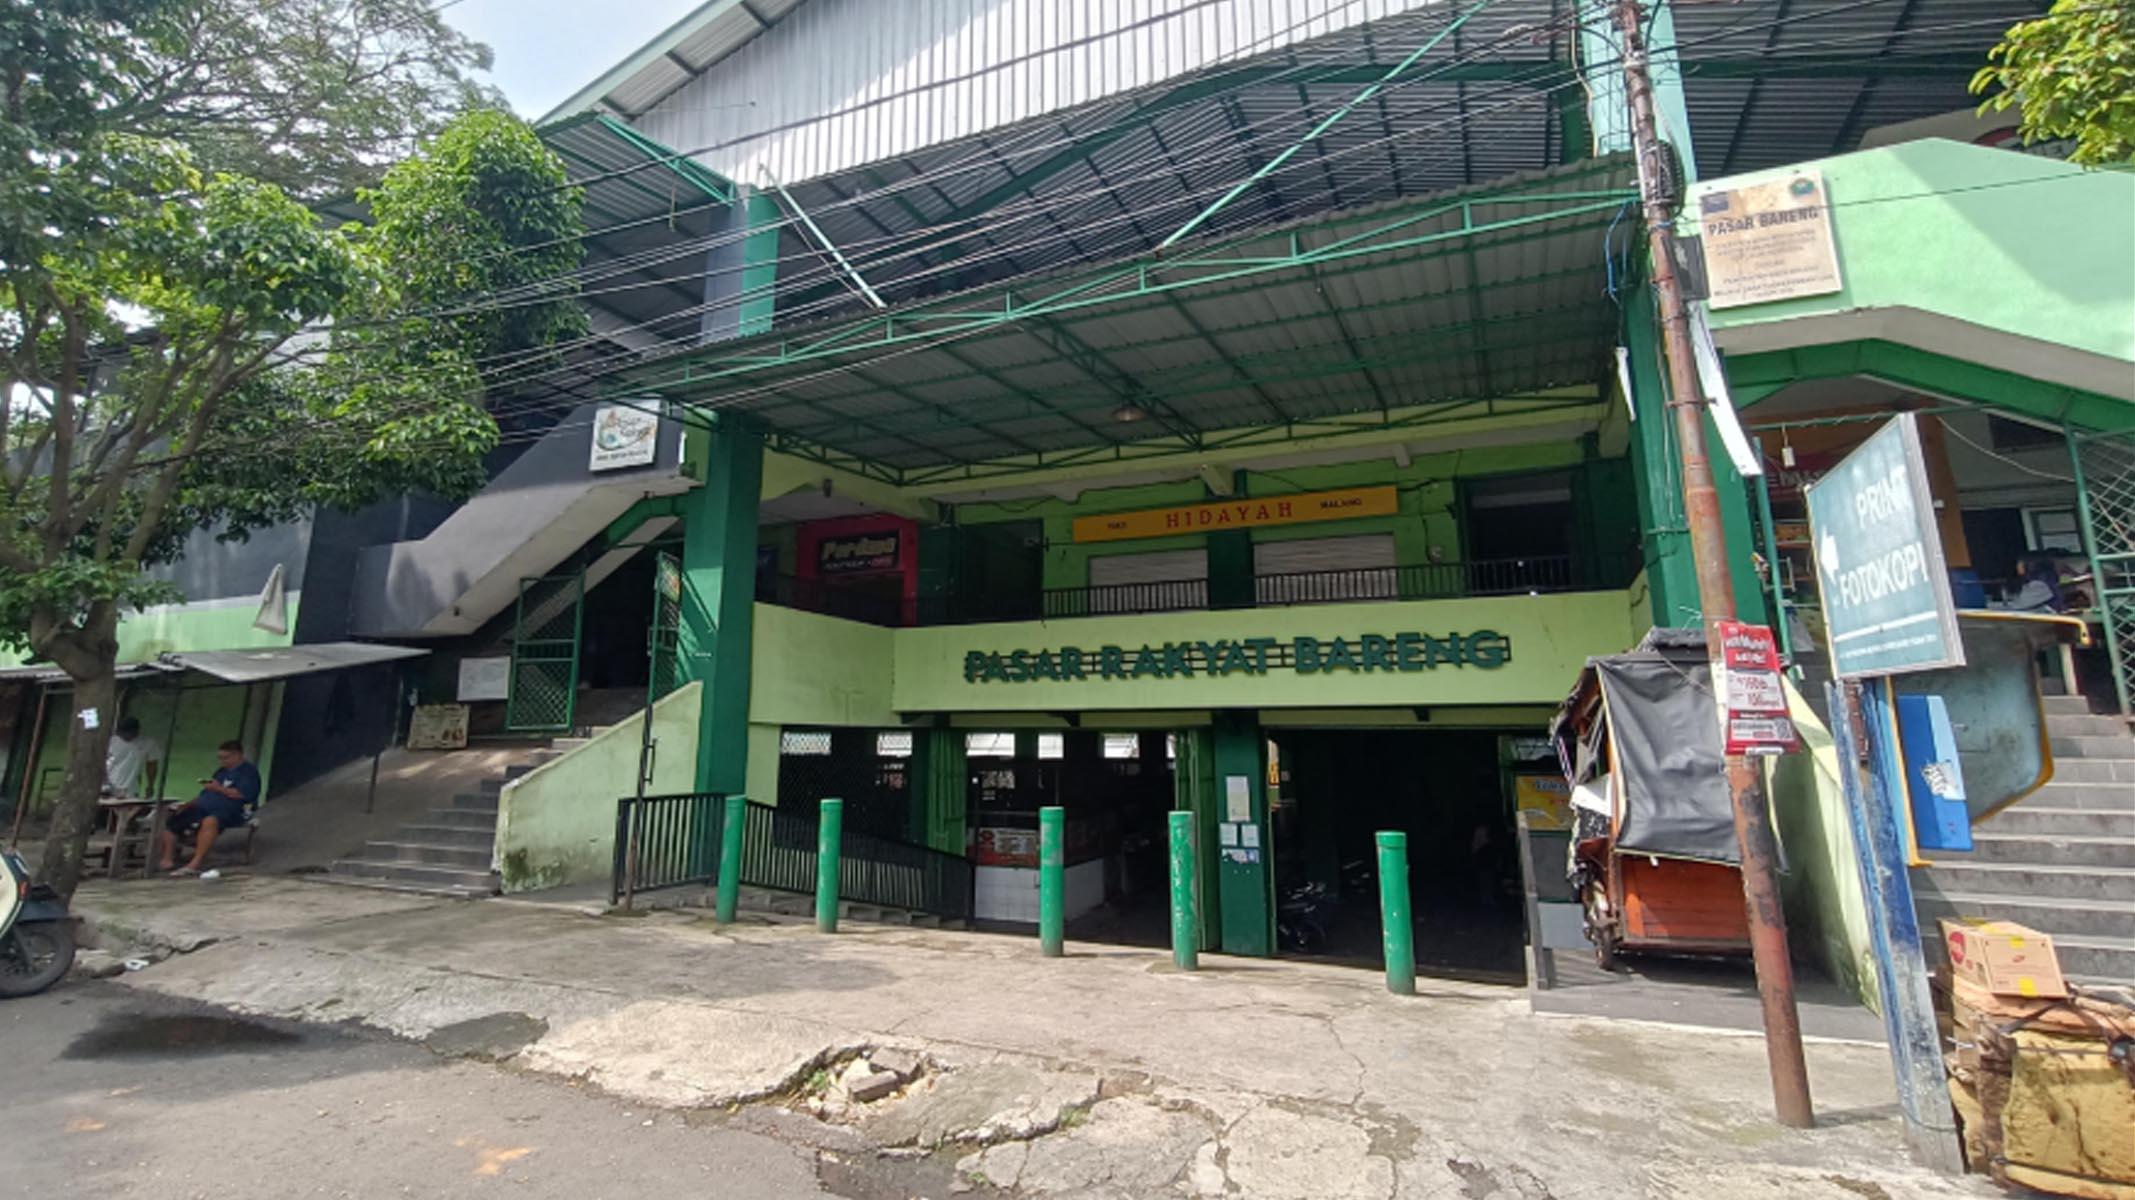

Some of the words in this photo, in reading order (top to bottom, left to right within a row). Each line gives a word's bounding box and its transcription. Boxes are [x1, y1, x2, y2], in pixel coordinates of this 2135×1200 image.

[1708, 216, 1754, 236] PASAR
[1758, 206, 1819, 228] BARENG
[1166, 501, 1294, 528] HIDAYAH
[1855, 463, 1911, 530] PRINT
[1839, 540, 1929, 609] FOTOKOPI
[964, 644, 1088, 684] PASAR
[1100, 637, 1277, 680] RAKYAT
[1293, 629, 1504, 675] BARENG
